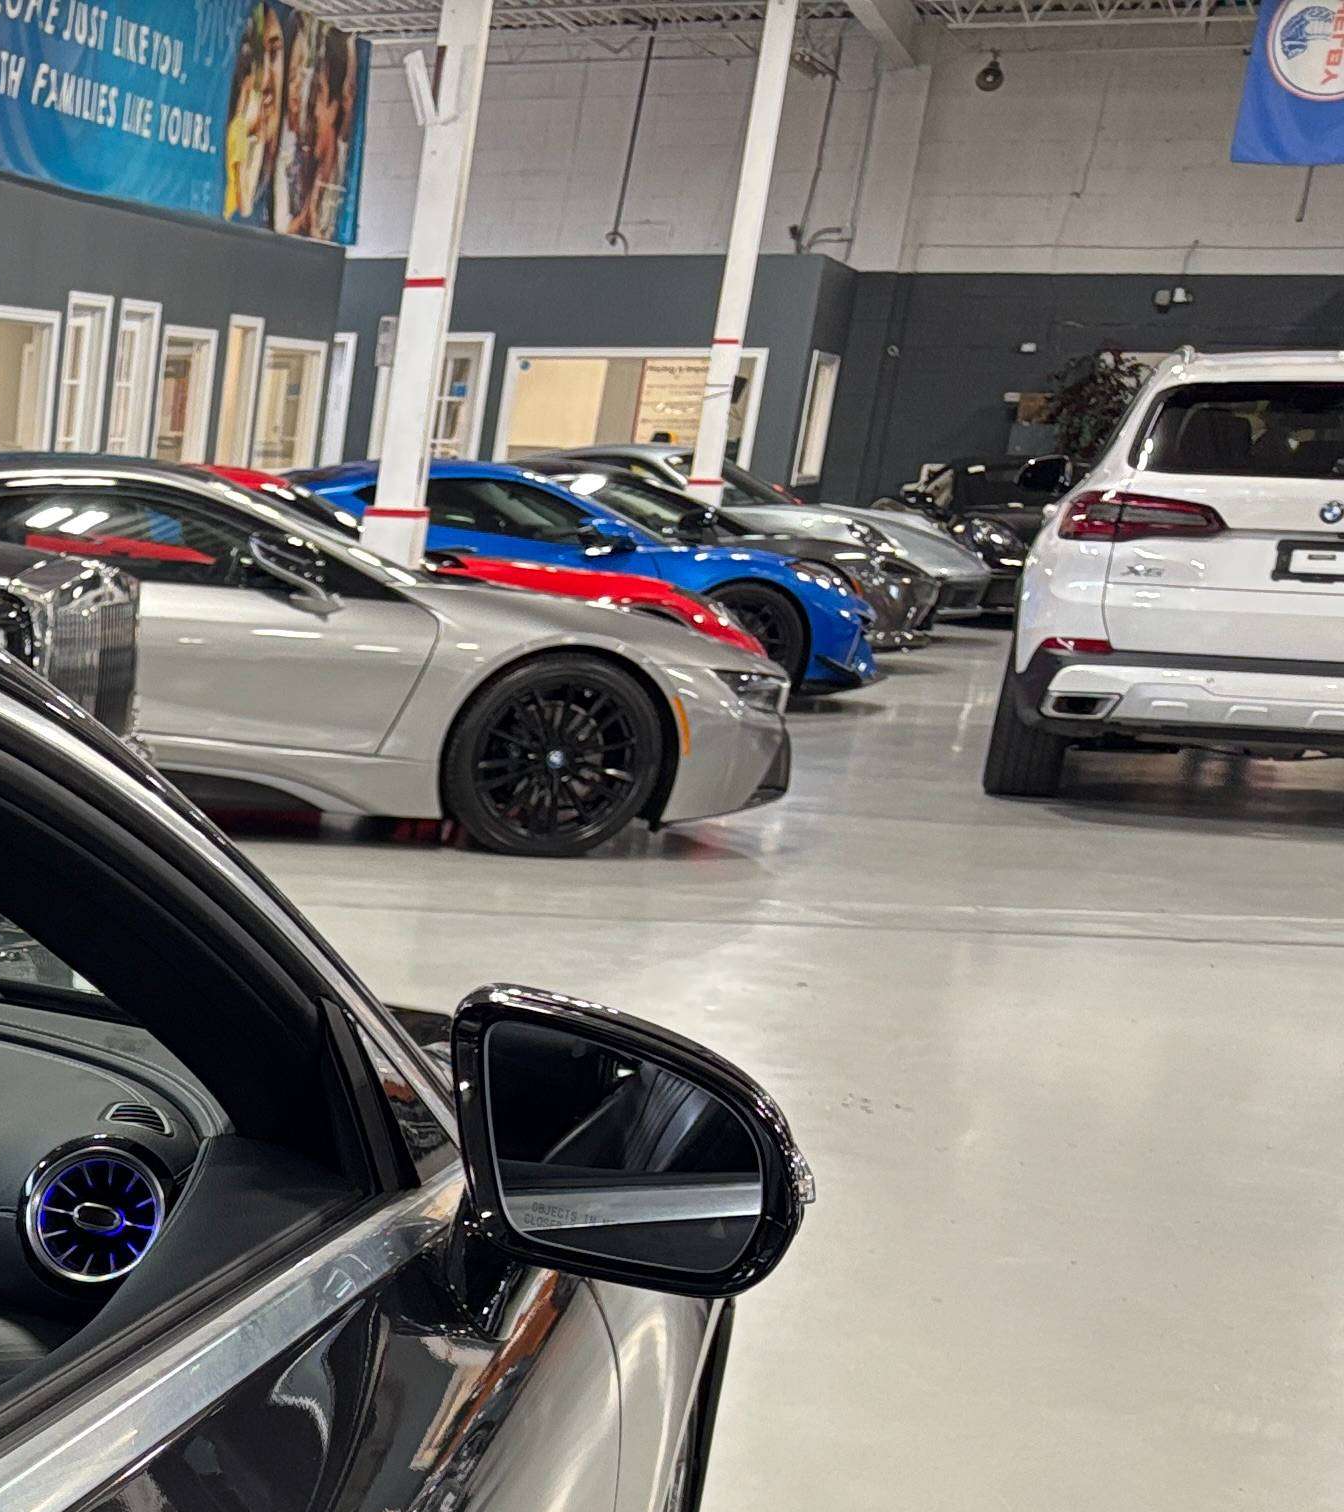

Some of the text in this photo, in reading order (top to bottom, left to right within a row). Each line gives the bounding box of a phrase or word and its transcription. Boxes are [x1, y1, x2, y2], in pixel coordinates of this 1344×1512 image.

[62, 0, 108, 50] JUST
[113, 16, 150, 65] LIKE
[30, 62, 119, 128] FAMILIES
[121, 92, 154, 139] LIKE
[531, 1202, 578, 1222] OBJECTS
